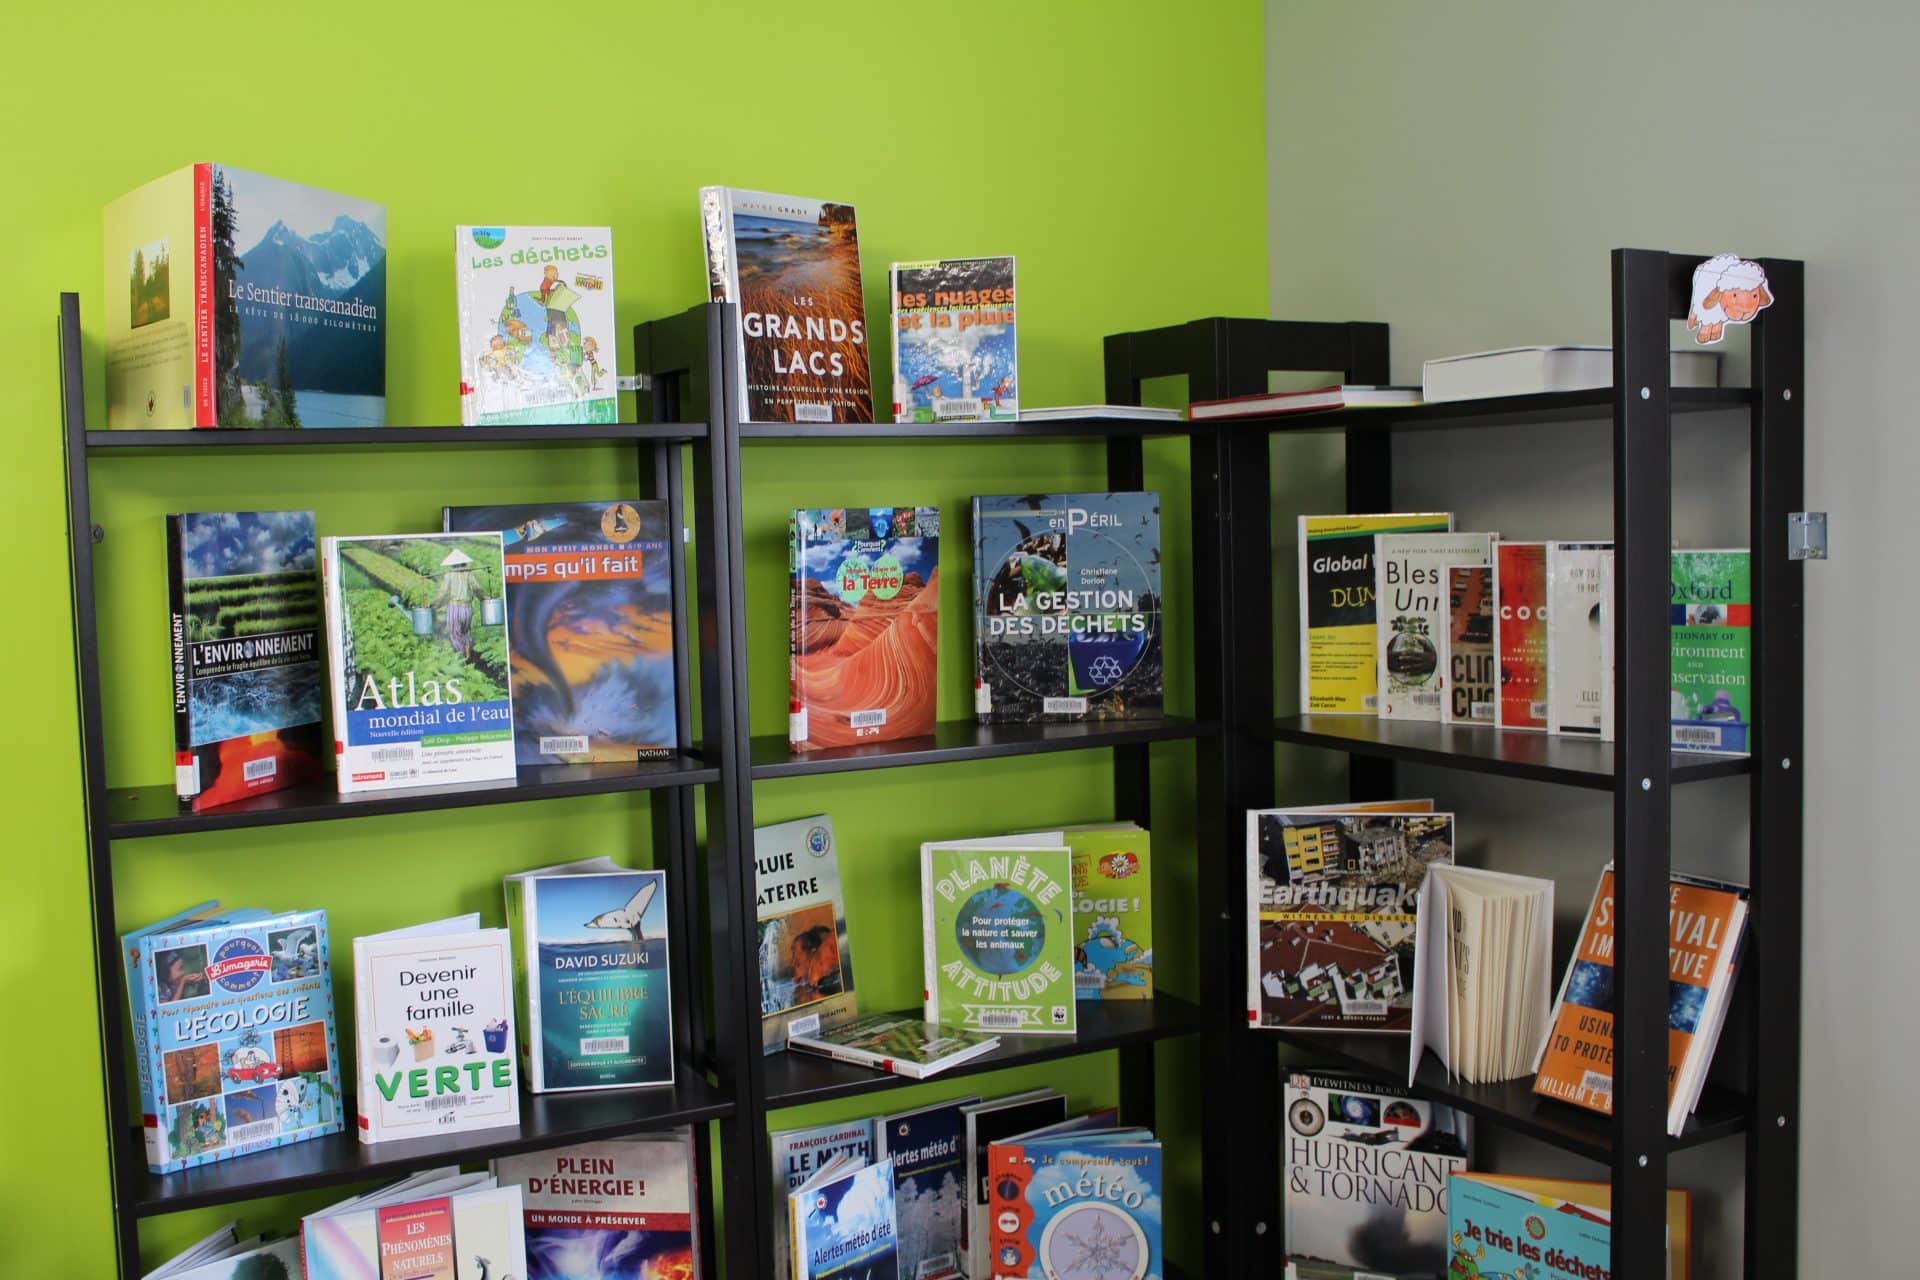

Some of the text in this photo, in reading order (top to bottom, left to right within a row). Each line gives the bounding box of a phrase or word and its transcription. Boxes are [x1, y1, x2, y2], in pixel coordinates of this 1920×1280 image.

[778, 205, 808, 216] GRADY
[472, 243, 608, 269] Les déchets
[228, 279, 377, 320] Le Sentier transcanadien
[793, 295, 814, 306] LES
[897, 288, 1014, 308] les nuages
[200, 309, 208, 348] SENTIER
[743, 312, 864, 345] GRANDS
[898, 308, 1014, 331] et la pluie
[773, 348, 844, 377] LACS
[782, 385, 821, 393] NATURELLE
[1049, 508, 1123, 536] en PÉRIL
[505, 556, 639, 580] mps qu'il fait
[1081, 568, 1118, 576] Christiane
[1313, 553, 1368, 573] Global
[1387, 560, 1439, 584] Bles
[843, 575, 899, 591] la Terre
[1081, 577, 1105, 585] Dorion
[1000, 590, 1133, 611] LA GESTION
[990, 617, 1033, 635] DES
[1722, 632, 1736, 640] OF
[193, 633, 313, 666] L'ENVIRONNEMENT
[195, 664, 225, 676] Comprendre
[232, 661, 248, 671] fragile
[354, 672, 464, 711] Atlas
[369, 706, 511, 729] mondial de l'eau
[370, 730, 400, 739] Nouvelle
[639, 750, 669, 758] NATHAN
[972, 916, 1029, 926] Pour protéger
[1282, 912, 1335, 920] WITNESS
[1343, 913, 1356, 921] TO
[962, 928, 1038, 938] la nature et sauver
[976, 940, 1025, 949] les animaux
[555, 951, 649, 969] DAVID SUZUKI
[400, 965, 477, 986] Devenir
[942, 960, 1063, 1003] ATTITUDE
[160, 1008, 179, 1017] Pour
[183, 1001, 218, 1013] répondre
[276, 988, 289, 997] des
[292, 981, 321, 994] enfants
[420, 987, 459, 1002] une
[559, 985, 648, 1005] L'ÉQUILIBRE
[175, 996, 311, 1042] L'ÉCOLOGIE
[406, 1000, 475, 1021] famille
[579, 1003, 630, 1021] SACRÉ
[1554, 1034, 1571, 1052] TO
[375, 1058, 512, 1102] VERTE
[1313, 1076, 1408, 1097] EYEWITNESS BOOKS
[1540, 1076, 1586, 1100] WILLIAM
[790, 1128, 865, 1151] FRANÇOIS CARDINAL
[921, 1139, 949, 1161] météo
[556, 1158, 614, 1175] PLEIN
[790, 1153, 810, 1174] LE
[1042, 1155, 1150, 1168] Je comprends tout!
[529, 1174, 635, 1196] D'ÉNERGIE
[1043, 1170, 1145, 1210] météo
[1290, 1166, 1310, 1194] &
[407, 1222, 425, 1235] LES
[531, 1213, 646, 1225] UN MONDE À PRÉSERVER
[814, 1221, 892, 1267] Alertes météo d'été
[1464, 1219, 1481, 1241] Je
[1485, 1226, 1513, 1253] trie
[1517, 1236, 1541, 1263] les
[393, 1251, 444, 1272] NATURELS
